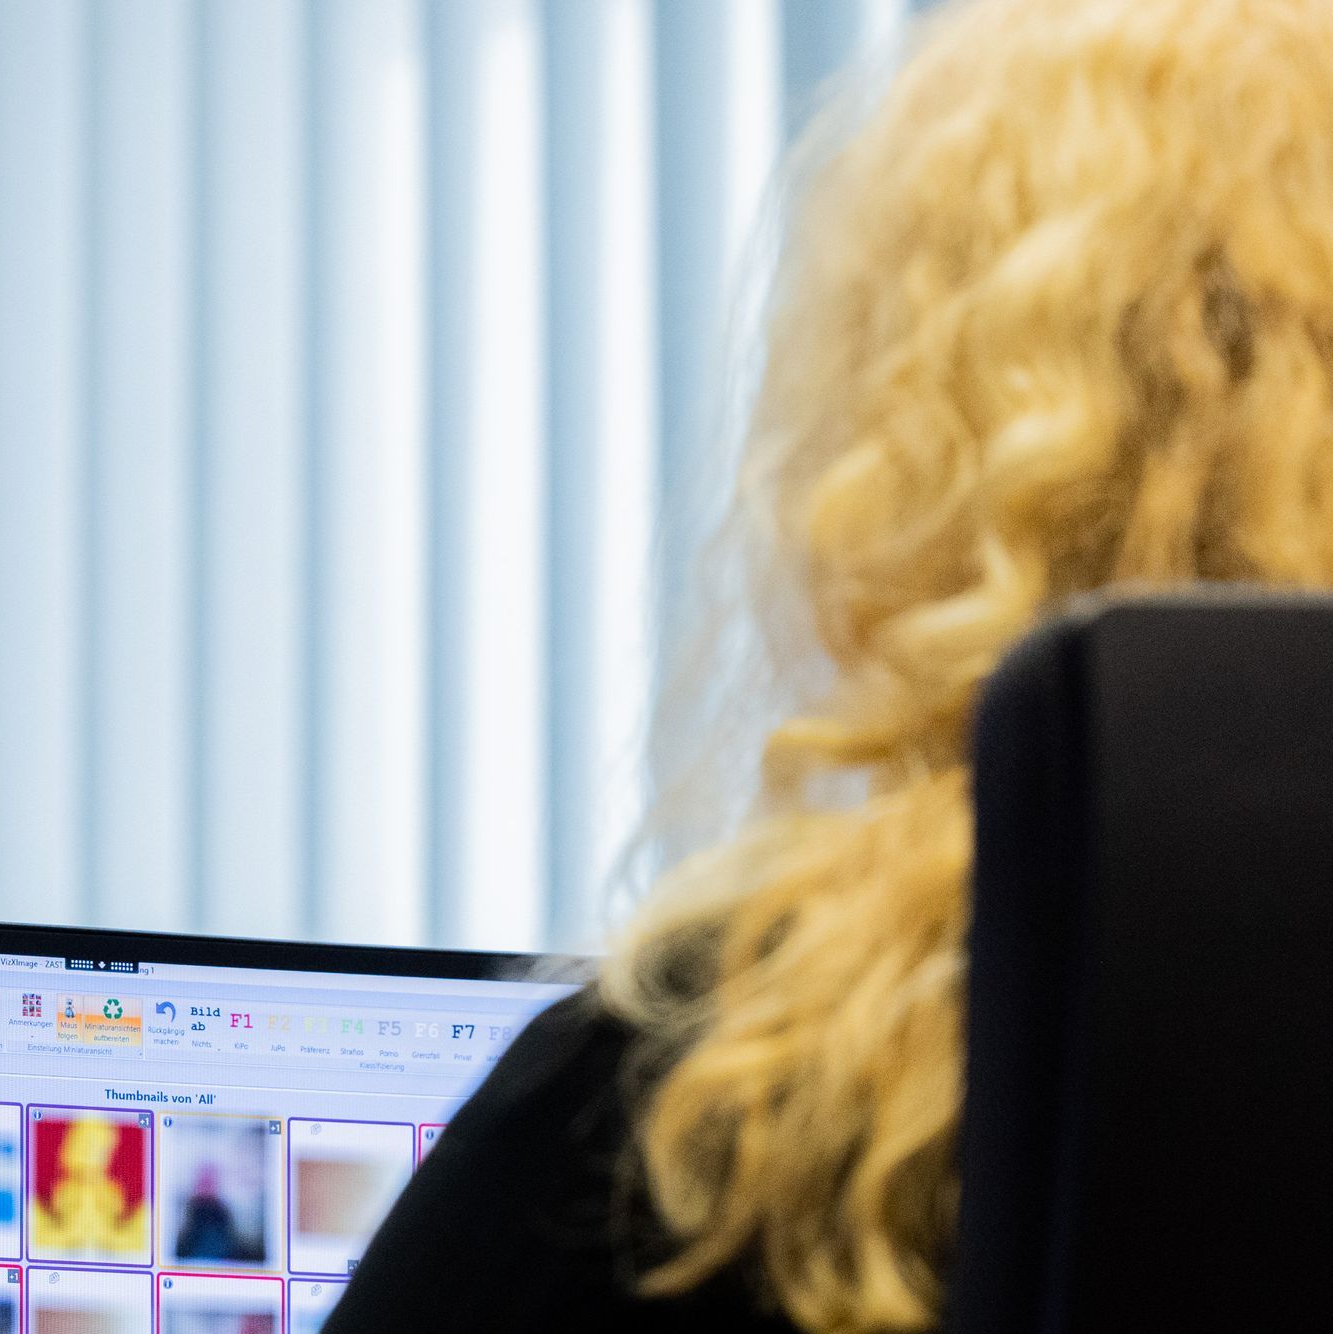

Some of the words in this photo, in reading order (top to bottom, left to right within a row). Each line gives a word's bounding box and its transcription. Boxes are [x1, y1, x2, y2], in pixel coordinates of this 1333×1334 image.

[190, 1006, 221, 1017] Bild
[9, 1018, 53, 1029] Anmerkungen
[60, 1021, 77, 1029] Maus
[191, 1021, 206, 1031] ab
[230, 1013, 254, 1029] F1
[341, 1019, 364, 1034] F4
[85, 1023, 141, 1033] Miniaturansichten
[148, 1026, 185, 1037] Rückgängig
[378, 1021, 401, 1036] F5
[415, 1022, 439, 1038] F6
[452, 1024, 475, 1039] F7
[489, 1026, 512, 1041] F8
[57, 1032, 78, 1041] folgen
[93, 1034, 129, 1043] aufbereiten
[153, 1038, 179, 1046] machen
[27, 1043, 61, 1054] Einstellung
[63, 1046, 112, 1055] Miniaturansicht
[191, 1040, 212, 1048] Nichts
[359, 1062, 404, 1072] Klassifizierung
[105, 1089, 169, 1103] Thumbnails
[171, 1094, 192, 1104] von
